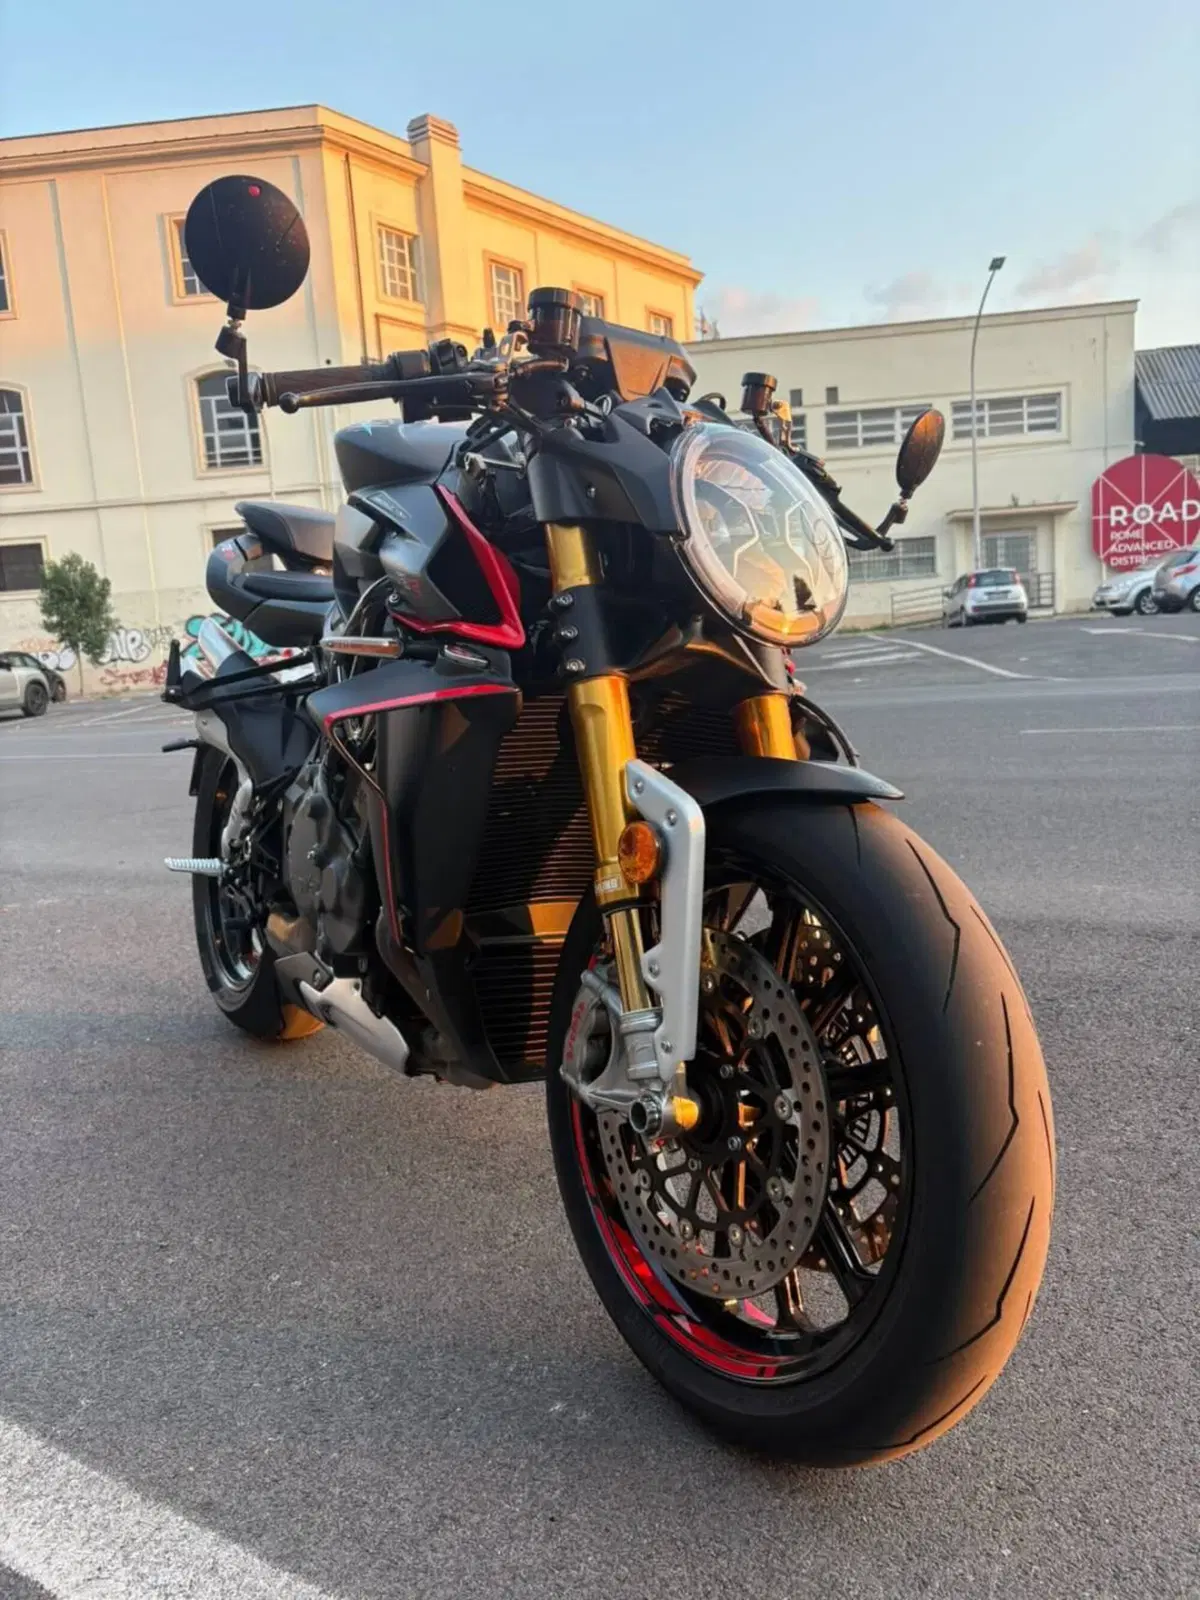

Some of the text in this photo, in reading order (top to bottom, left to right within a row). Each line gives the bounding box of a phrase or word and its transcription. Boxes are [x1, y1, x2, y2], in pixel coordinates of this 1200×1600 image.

[1110, 500, 1200, 526] ROAD
[1110, 530, 1141, 540] ROME
[1110, 541, 1172, 552] ADVANCED
[1110, 554, 1160, 566] DISTRI
